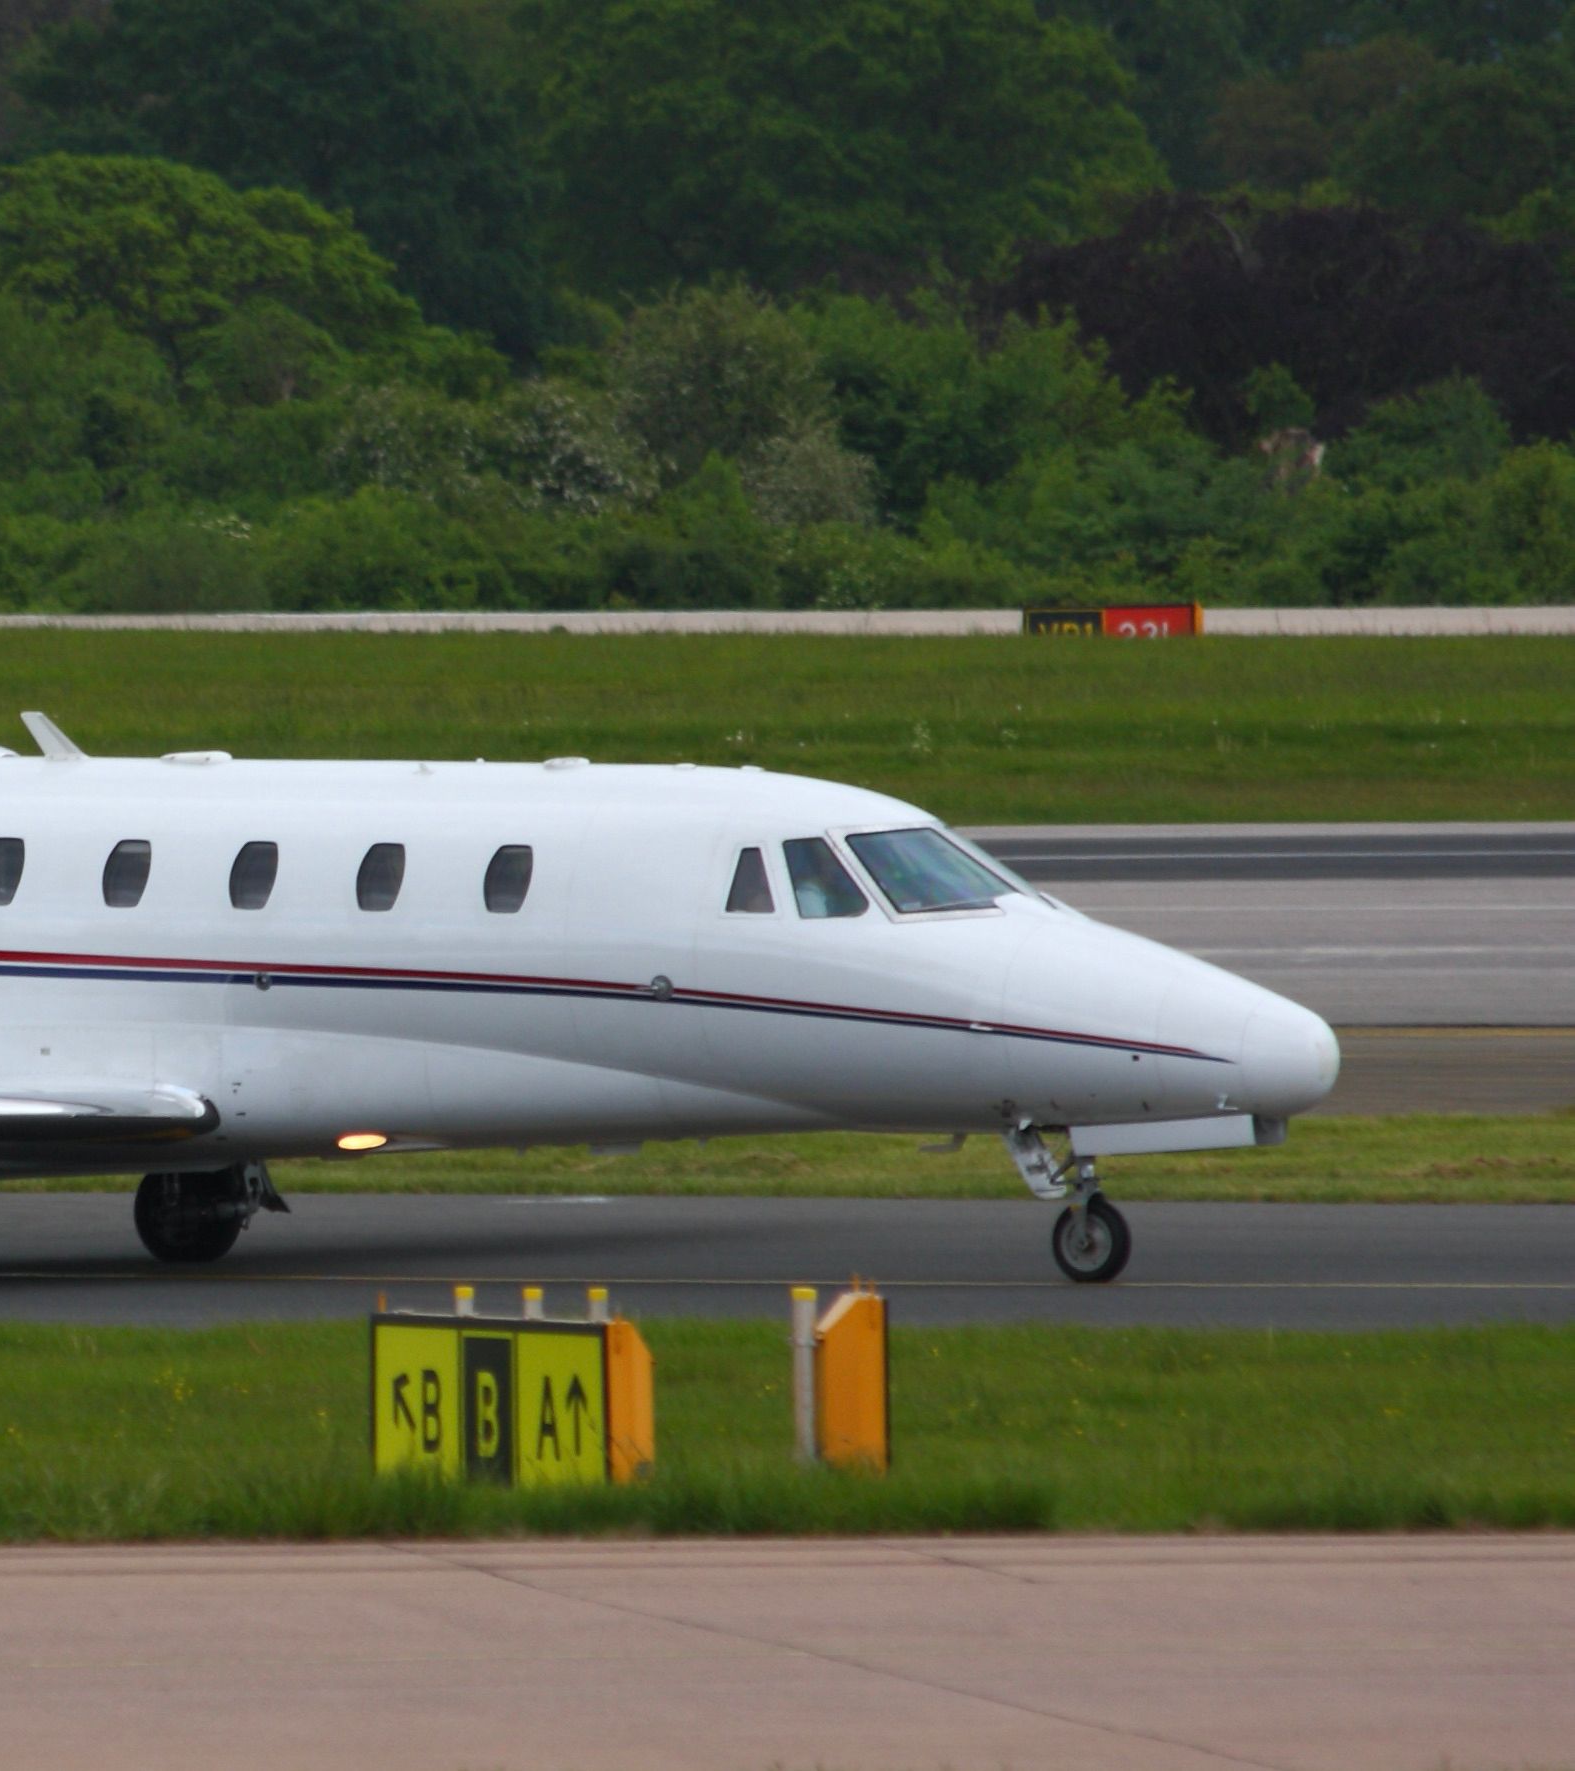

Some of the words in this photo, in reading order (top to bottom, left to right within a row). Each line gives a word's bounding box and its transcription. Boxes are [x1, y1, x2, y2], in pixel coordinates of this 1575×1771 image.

[421, 1369, 441, 1453] B
[477, 1371, 500, 1458] B
[537, 1375, 560, 1461] A
